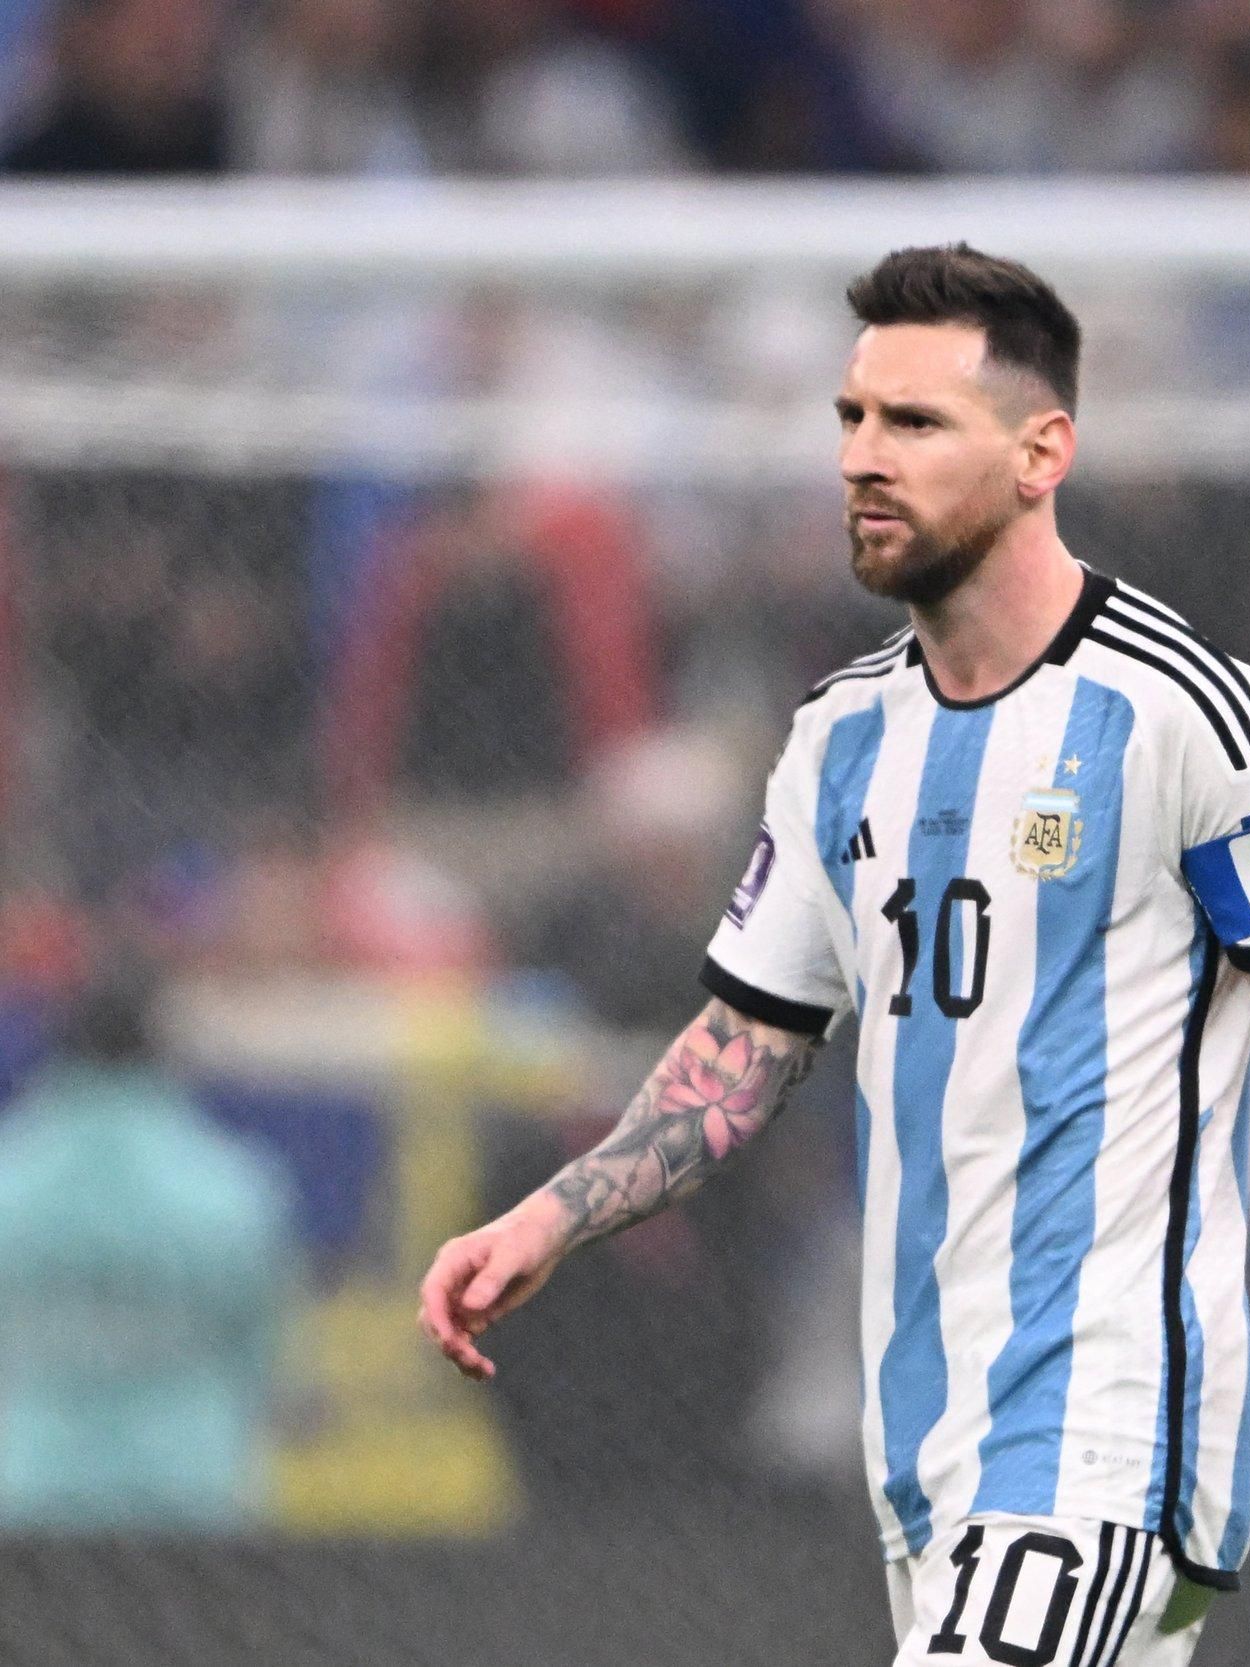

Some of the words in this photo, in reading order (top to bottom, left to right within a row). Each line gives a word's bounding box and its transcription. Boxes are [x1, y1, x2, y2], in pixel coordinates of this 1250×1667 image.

[1024, 811, 1063, 856] AFA
[881, 878, 992, 1019] 10
[926, 1524, 1084, 1667] 10
